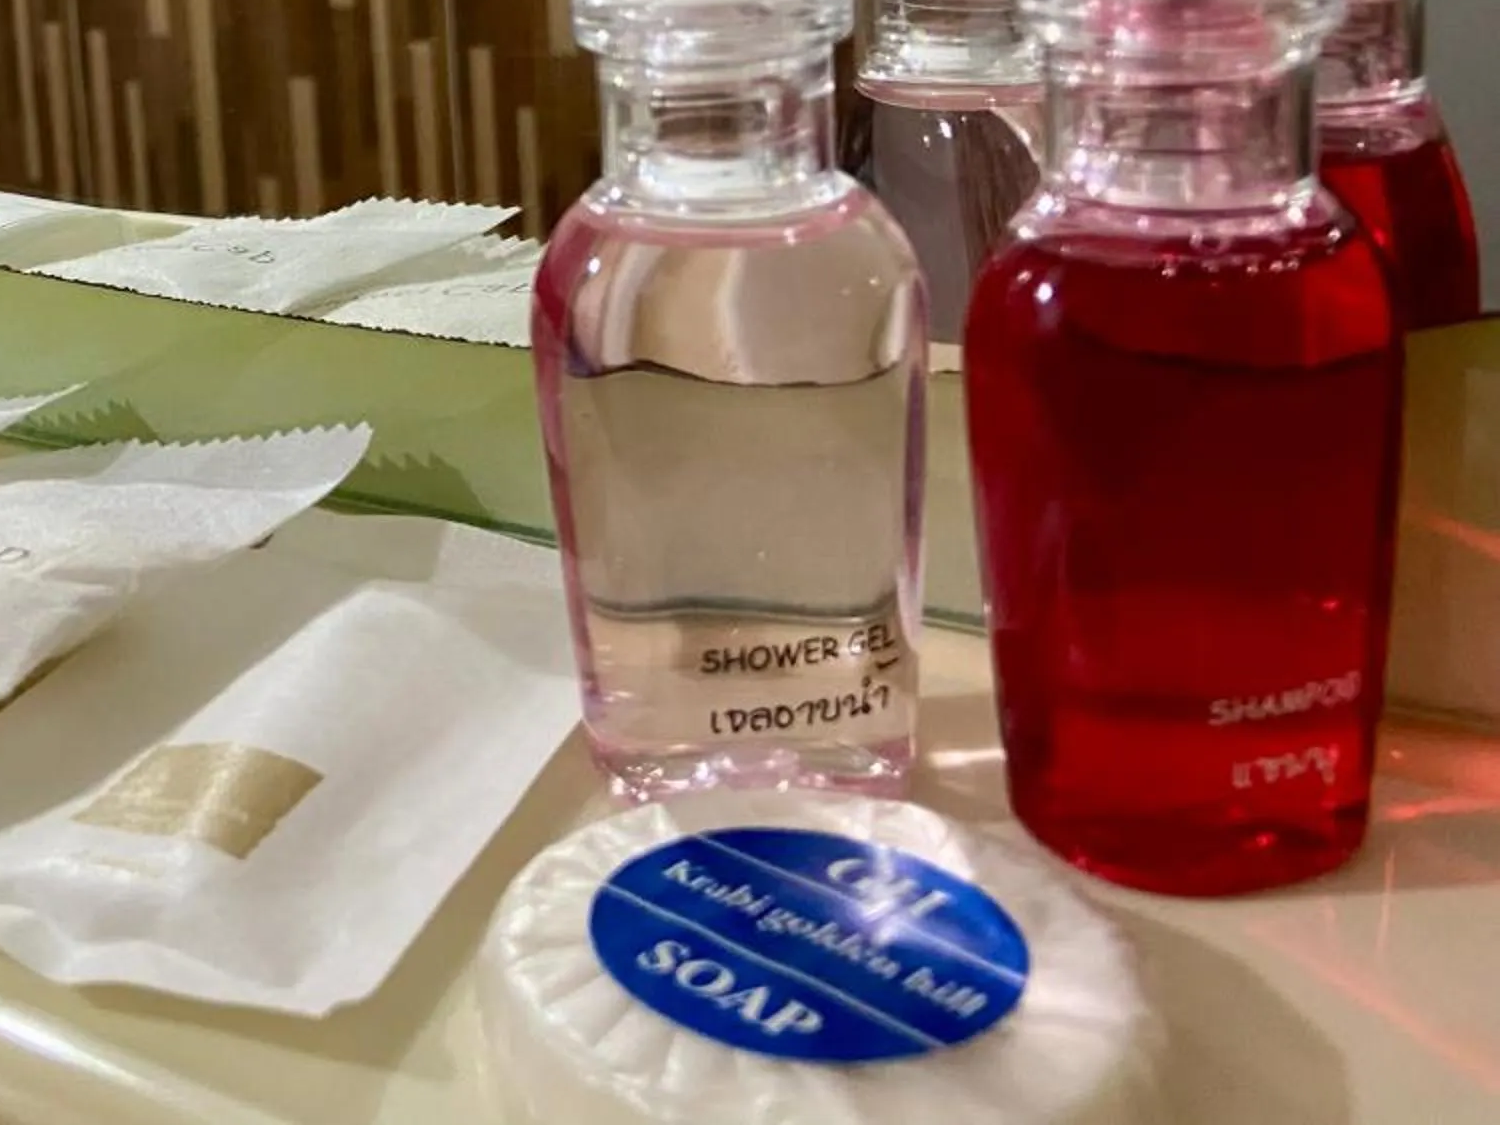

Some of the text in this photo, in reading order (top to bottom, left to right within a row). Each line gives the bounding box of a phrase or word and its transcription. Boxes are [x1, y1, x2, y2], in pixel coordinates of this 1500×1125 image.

[700, 624, 895, 675] SHOWER GEL
[635, 938, 825, 1037] SOAP
[662, 859, 772, 918] Krabi
[902, 966, 989, 1020] hill
